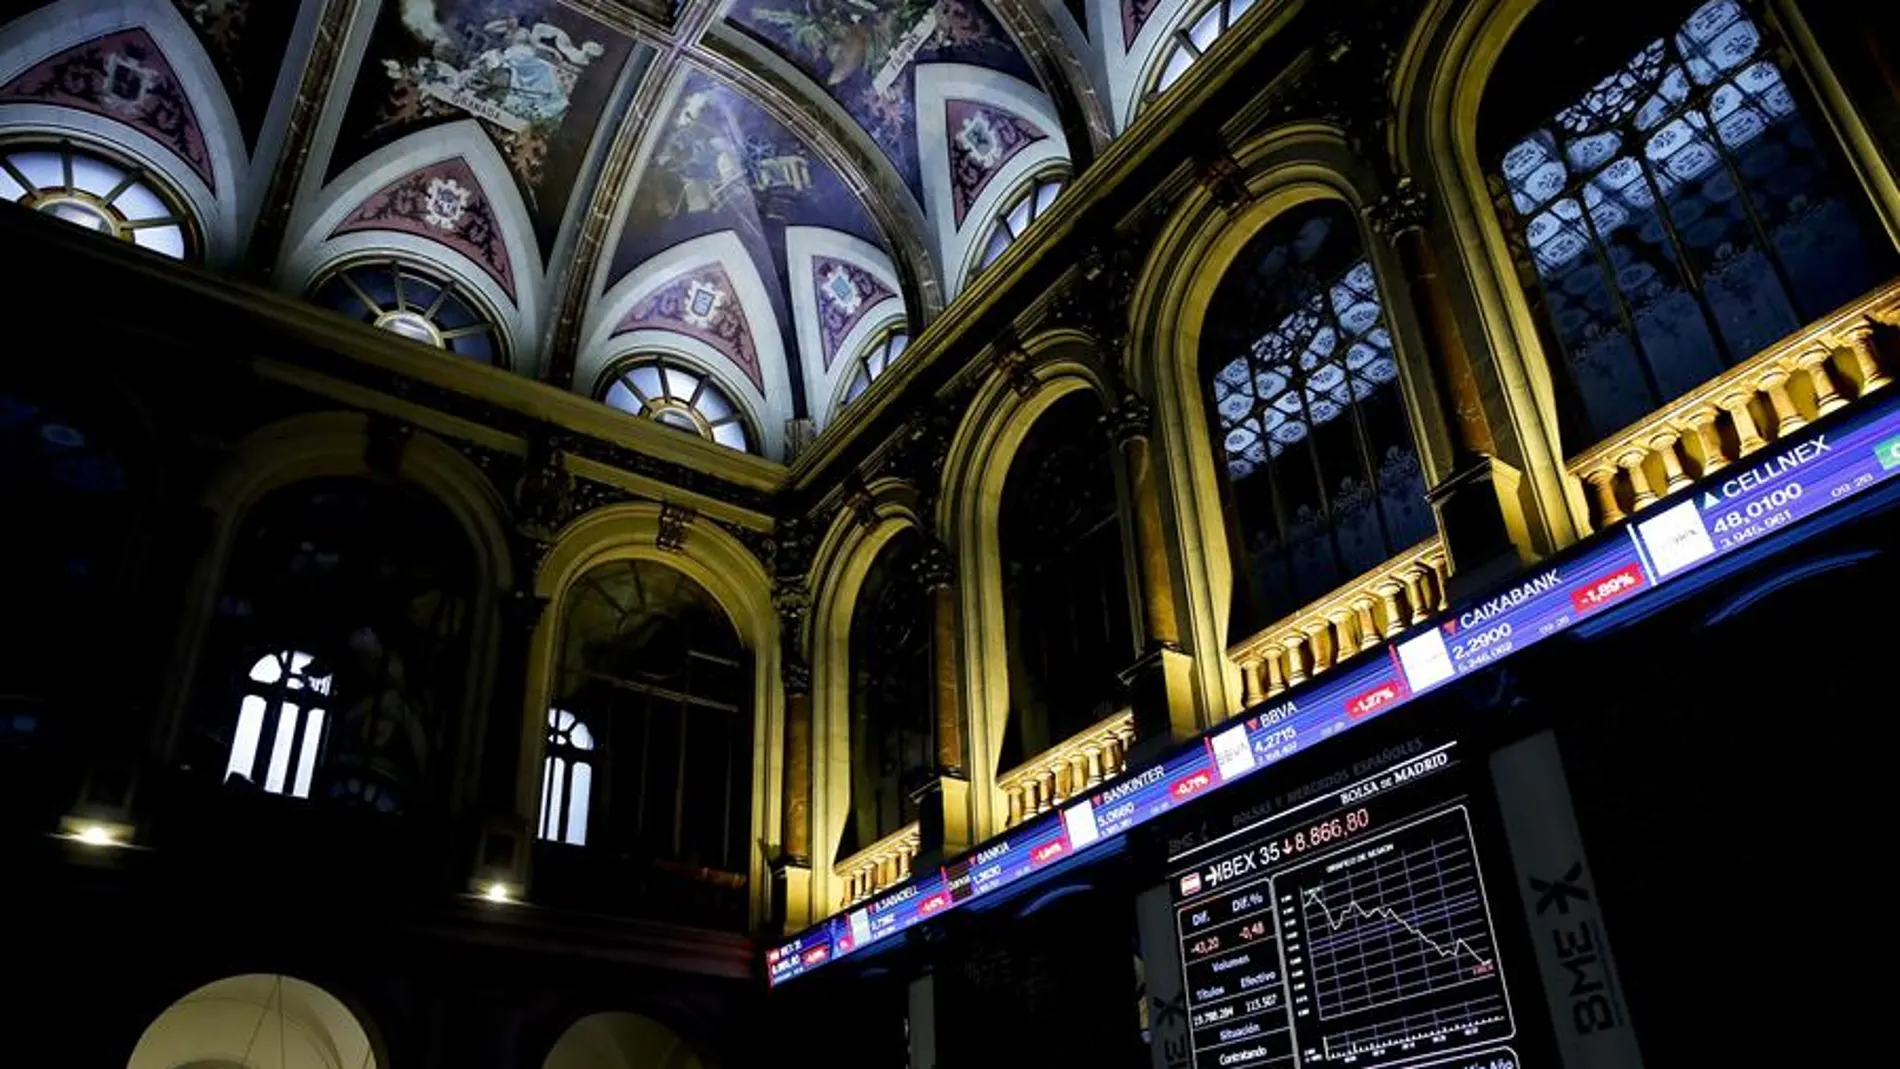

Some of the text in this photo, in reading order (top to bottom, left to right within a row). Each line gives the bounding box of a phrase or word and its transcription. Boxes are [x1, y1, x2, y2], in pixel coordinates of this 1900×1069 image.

[1722, 434, 1832, 498] CELLNEX
[1713, 482, 1803, 534] 48,0100
[1460, 568, 1563, 629] CAIXABANK
[1580, 572, 1636, 605] -1,89%
[1452, 622, 1513, 661] 2,2900
[1259, 701, 1300, 729] BBVA
[1103, 765, 1165, 804] BANKINTER
[1340, 779, 1380, 807] BOLSA
[1393, 751, 1449, 786] MADRID
[1215, 807, 1371, 884] IBEX 35 8.866,80
[1192, 910, 1211, 927] Dif.
[1211, 954, 1251, 973] Volumen
[1240, 971, 1277, 989] Efectivo
[1219, 1022, 1261, 1041] Situación
[1219, 1044, 1268, 1066] Contratando
